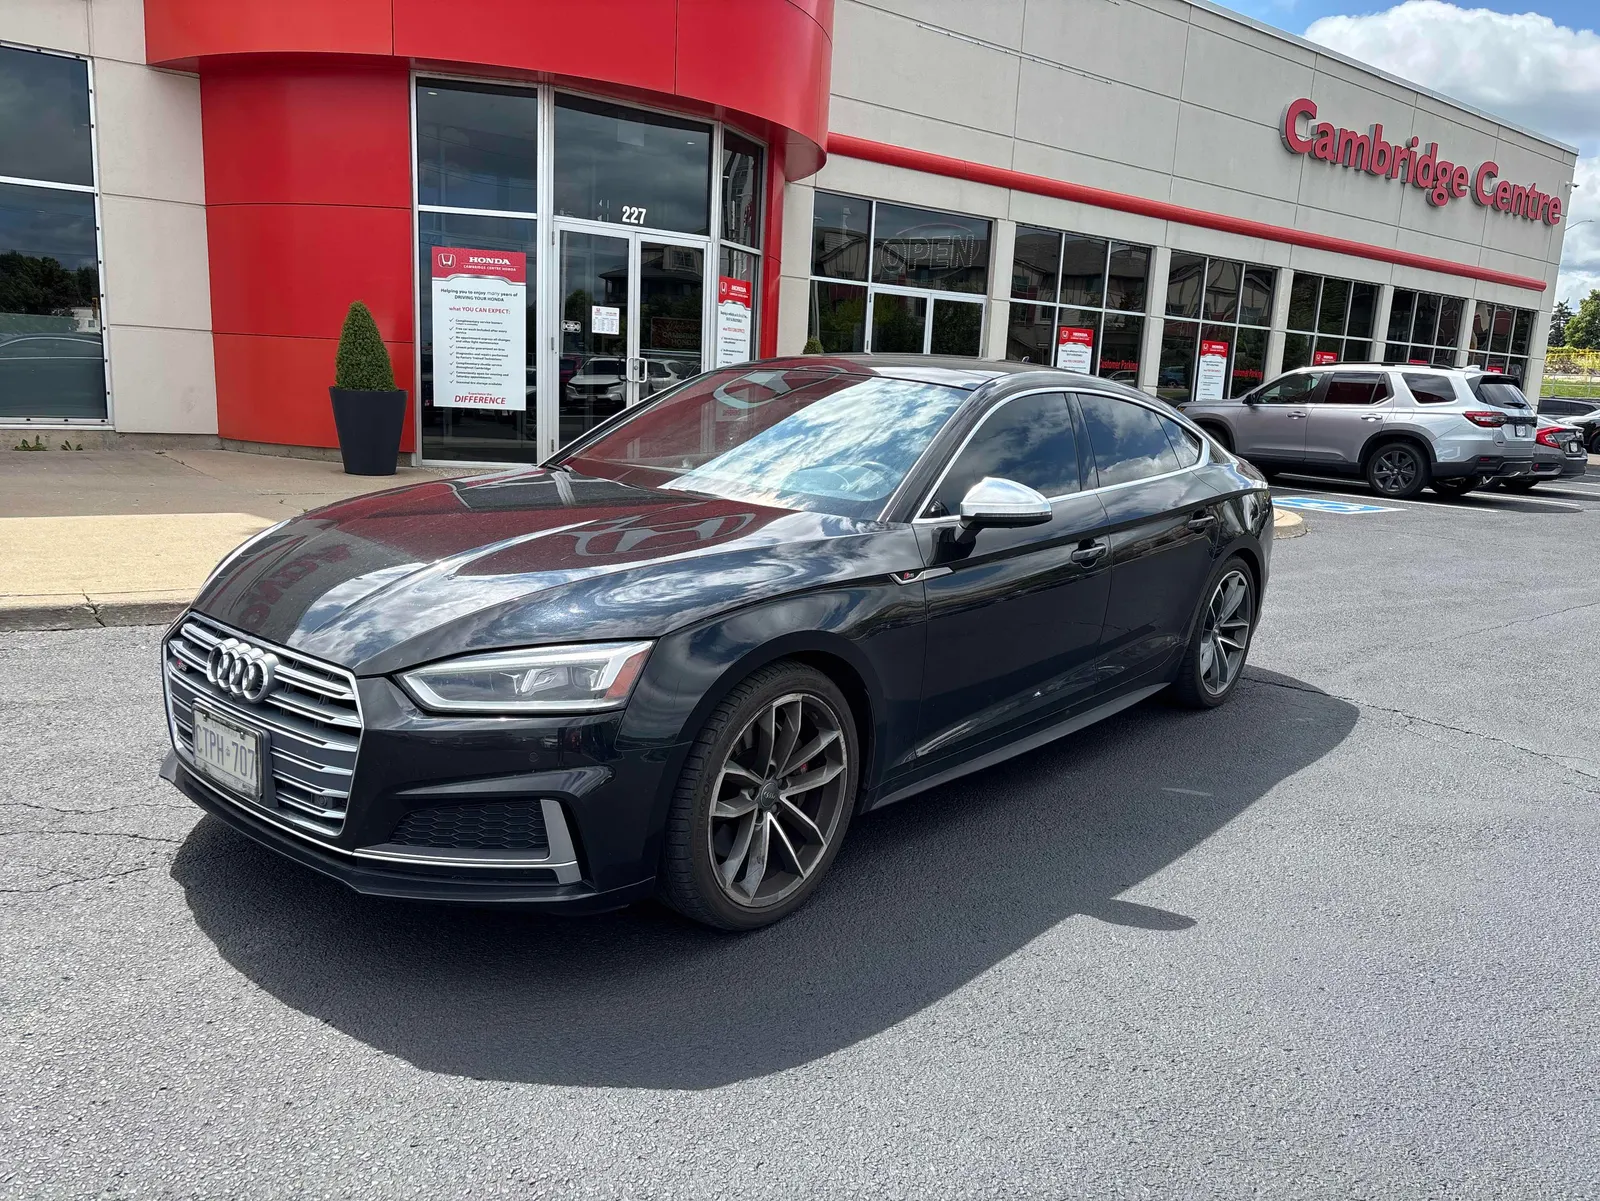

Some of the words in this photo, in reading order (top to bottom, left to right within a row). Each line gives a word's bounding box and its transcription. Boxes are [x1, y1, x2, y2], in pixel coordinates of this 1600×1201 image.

[1281, 98, 1469, 207] Cambridge
[1473, 161, 1562, 226] Centre
[622, 205, 647, 225] 227
[469, 257, 511, 265] HONDA
[881, 234, 975, 274] OPEN
[454, 395, 506, 405] DIFFERENCE
[196, 724, 225, 767] CTPH
[232, 741, 255, 780] 707
